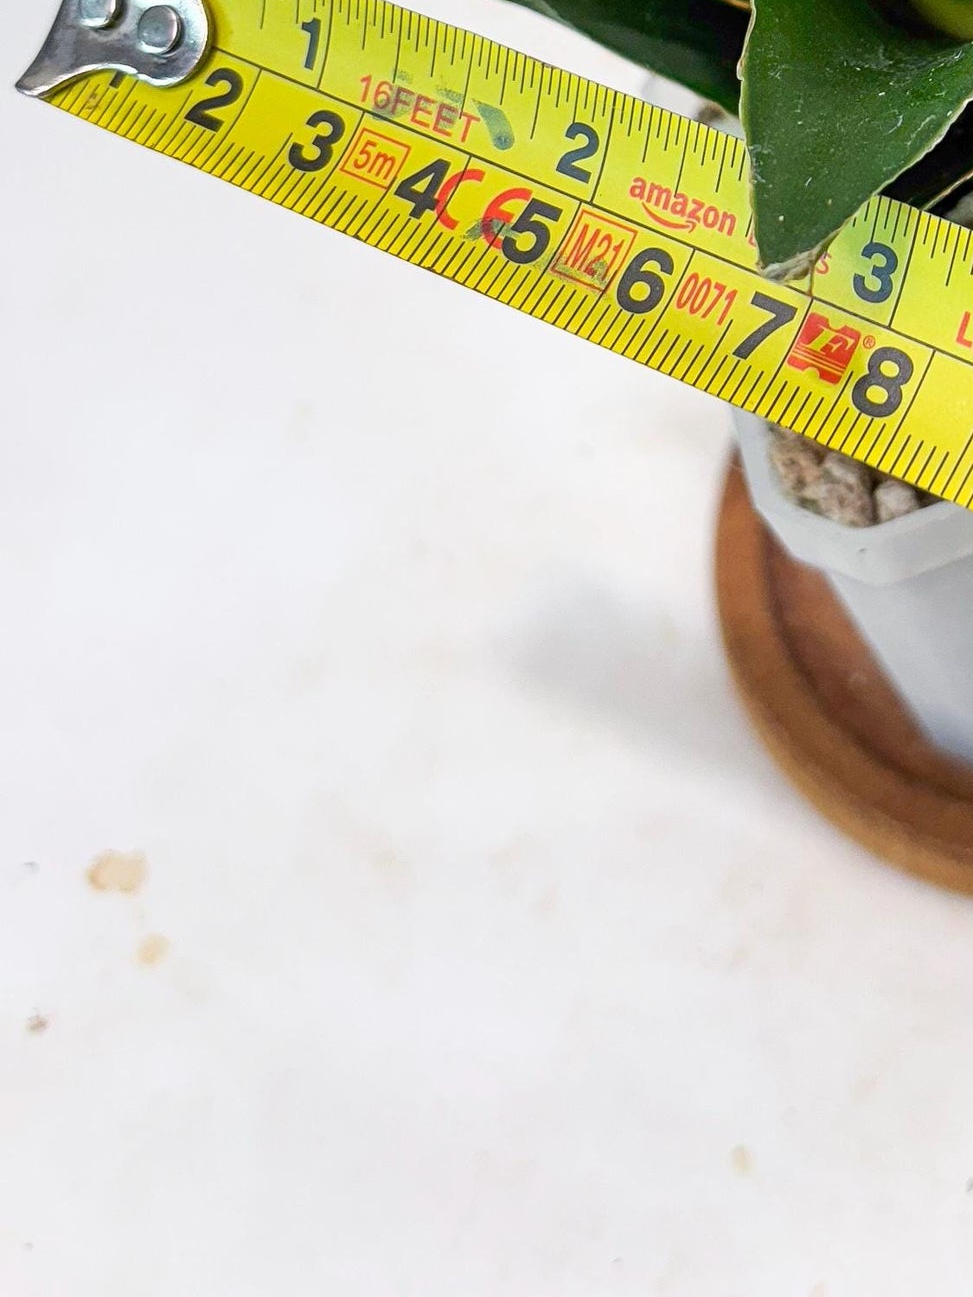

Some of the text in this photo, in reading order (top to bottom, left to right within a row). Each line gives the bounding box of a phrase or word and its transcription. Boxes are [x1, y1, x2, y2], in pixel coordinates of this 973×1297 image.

[300, 17, 322, 71] 1
[184, 68, 244, 133] 2
[359, 74, 481, 144] 16FEET
[287, 110, 346, 173] 3
[353, 139, 397, 181] 5m
[556, 122, 600, 184] 2
[394, 158, 451, 220] 4
[629, 176, 737, 237] amazon
[501, 197, 563, 265] 5
[616, 247, 675, 315] 6
[676, 271, 739, 327] 0071
[853, 242, 898, 303] 3
[731, 291, 798, 360] 7
[851, 346, 915, 419] 8
